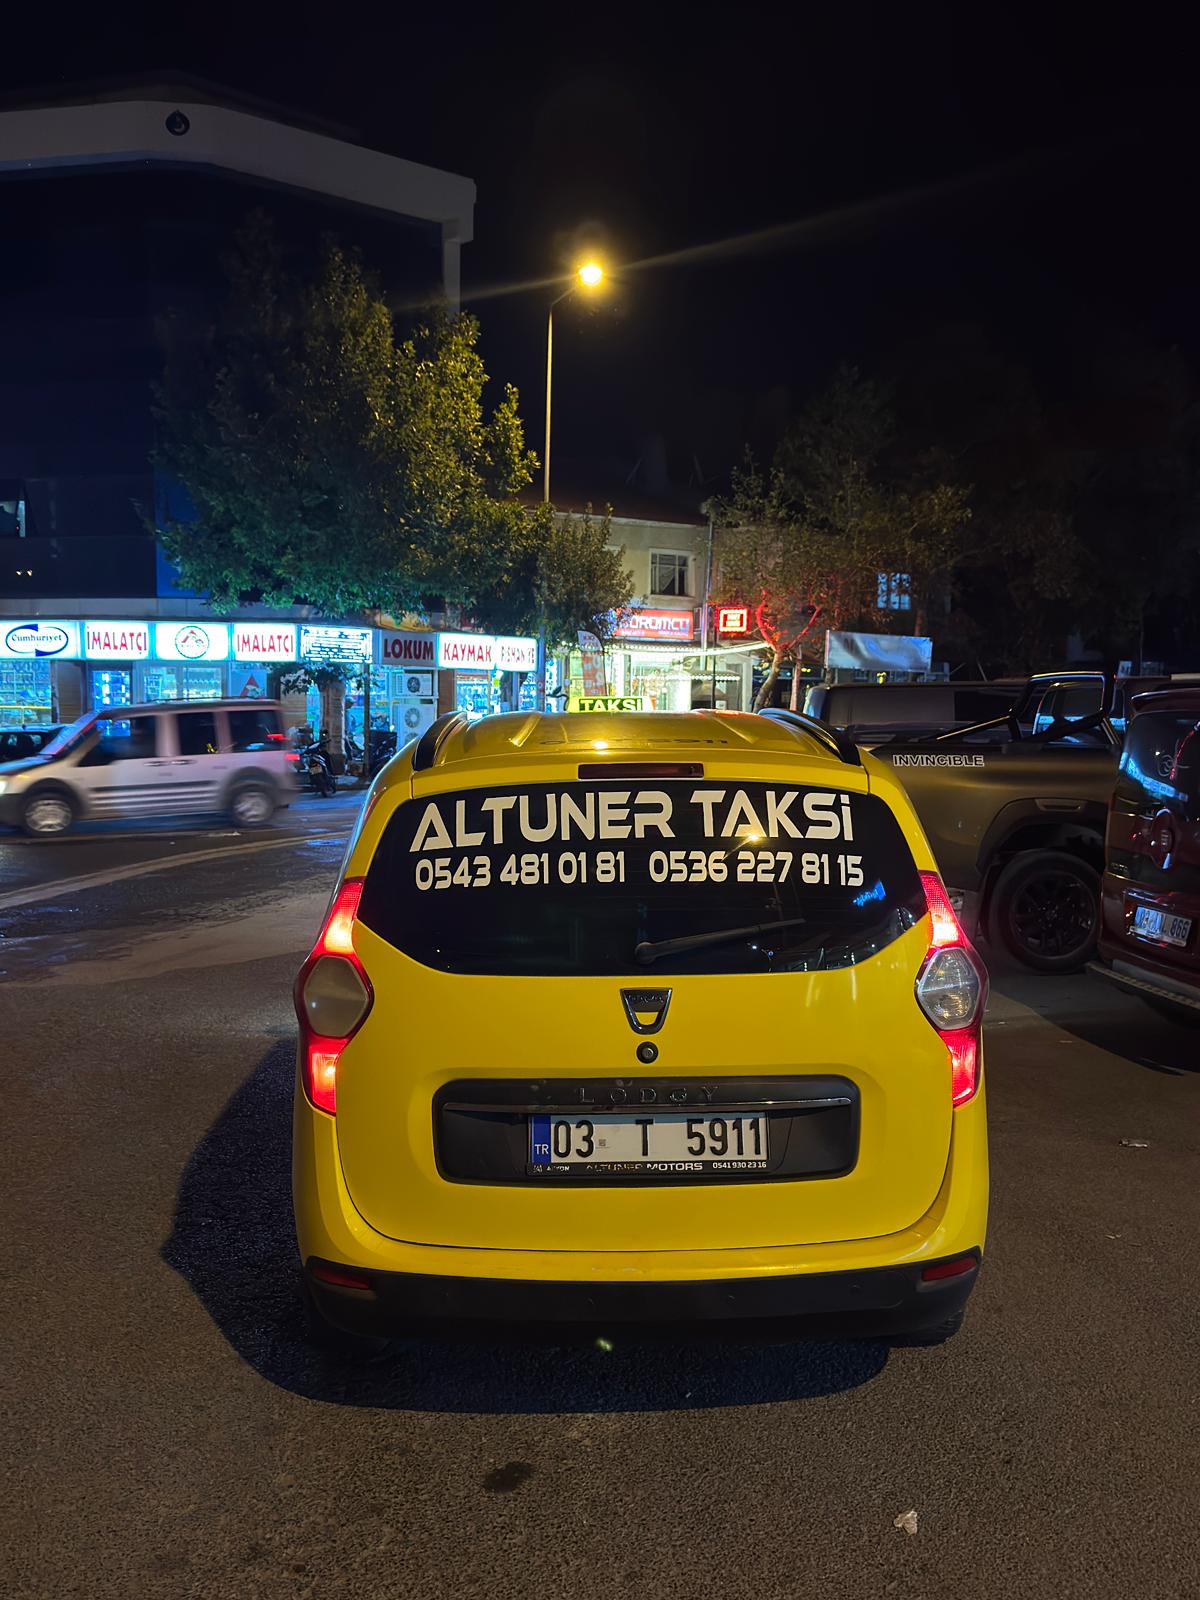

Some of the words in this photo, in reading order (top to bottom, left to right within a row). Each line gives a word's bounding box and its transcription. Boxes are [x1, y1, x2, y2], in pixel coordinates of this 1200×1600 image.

[11, 633, 62, 644] Cumhuriyet
[86, 625, 147, 655] İMALATÇI
[383, 638, 434, 660] LOKUM
[443, 642, 492, 662] KAYMAK
[893, 754, 985, 767] INVINCIBLE
[409, 790, 675, 852] ALTUNER
[415, 855, 491, 891] 0543
[500, 853, 549, 885] 481
[558, 851, 587, 884] 01
[596, 851, 625, 883] 81
[649, 850, 728, 883] 0536
[736, 851, 793, 883] 227
[801, 852, 830, 885] 81
[836, 854, 864, 887] 15
[579, 1086, 719, 1103] LODGY
[553, 1120, 594, 1158] 03
[635, 1118, 654, 1157] T
[686, 1117, 761, 1156] 5911
[534, 1143, 549, 1155] TR
[646, 1162, 703, 1171] MOTORS
